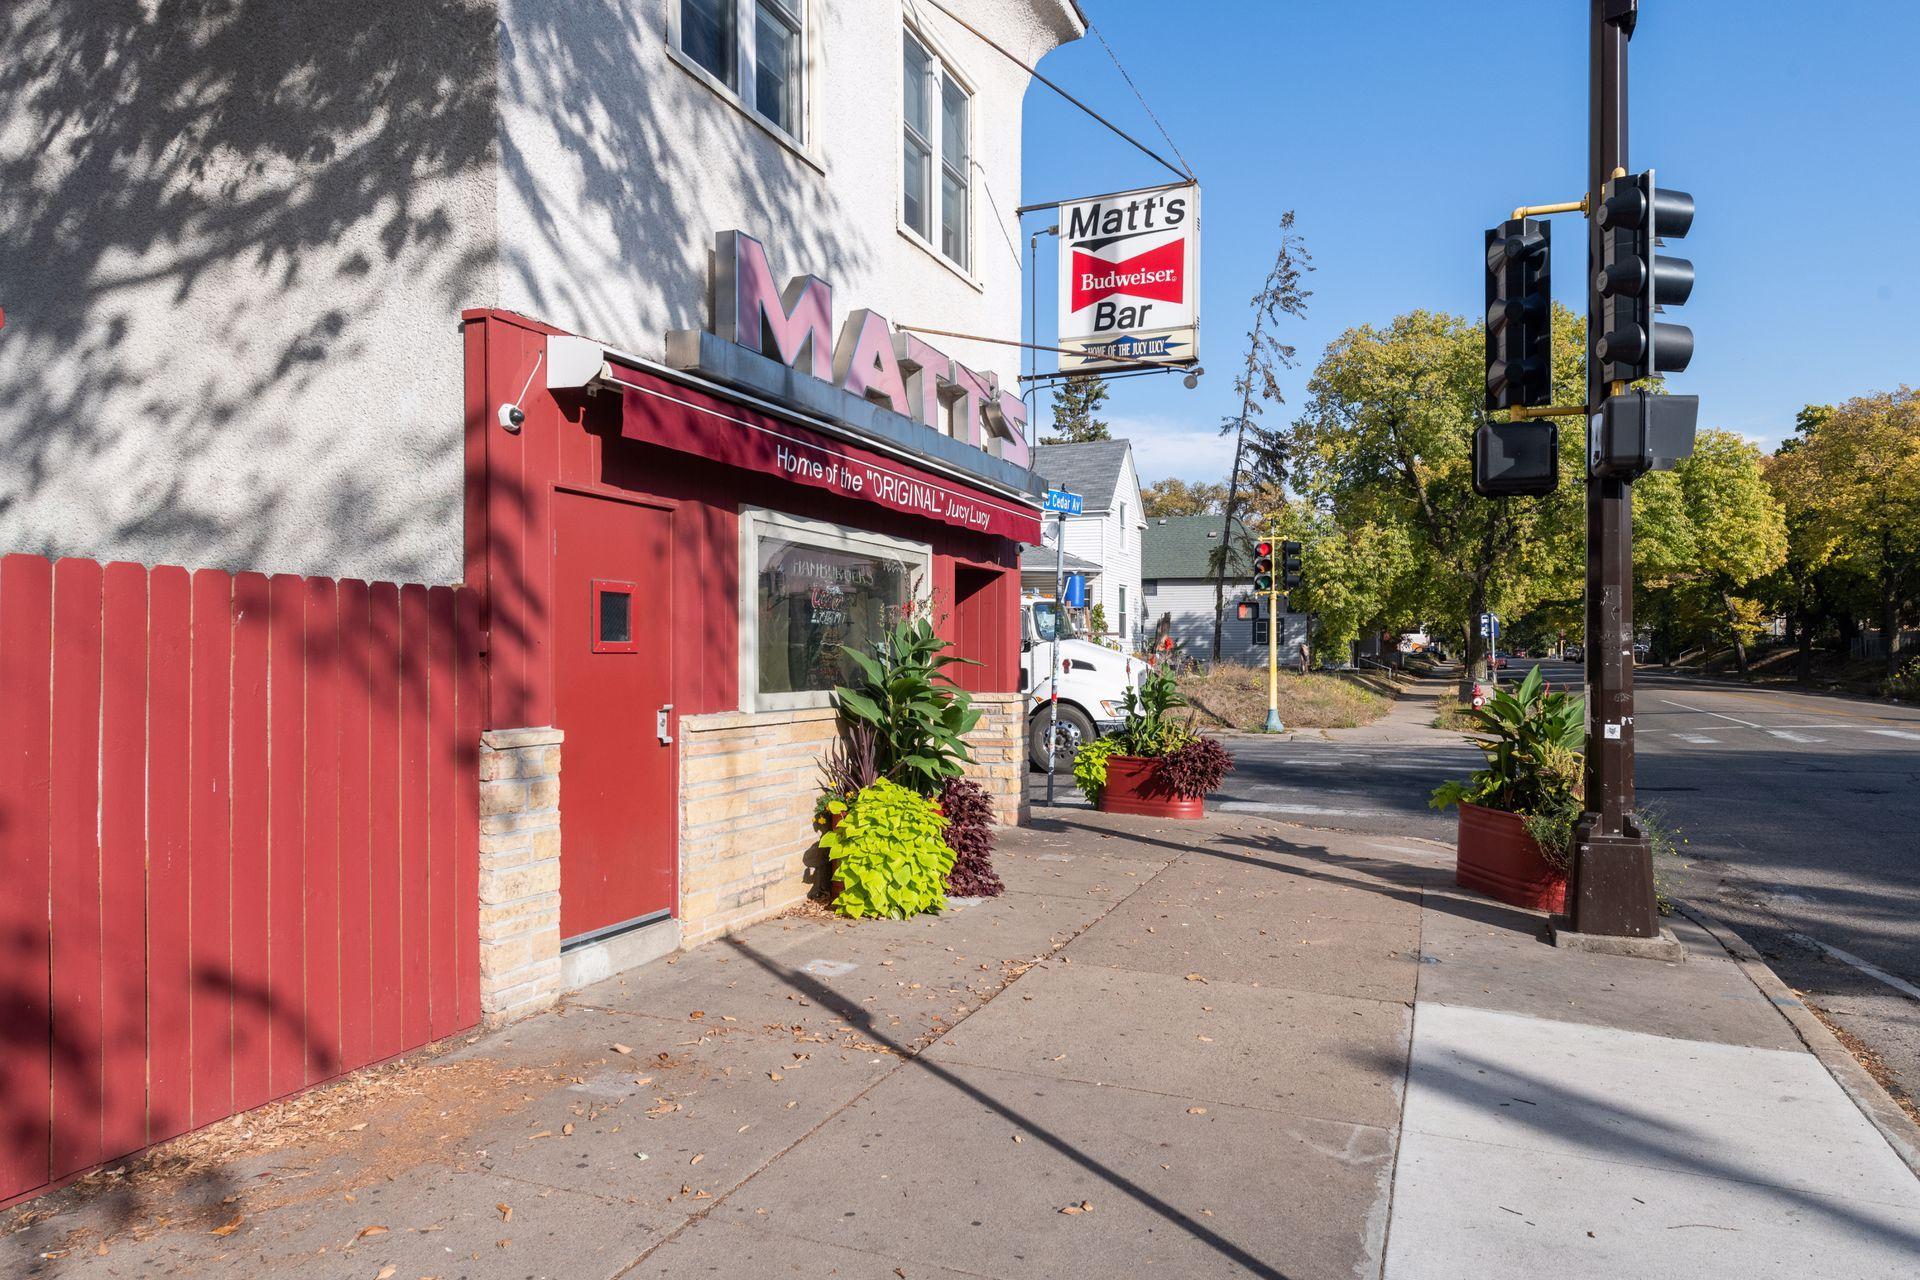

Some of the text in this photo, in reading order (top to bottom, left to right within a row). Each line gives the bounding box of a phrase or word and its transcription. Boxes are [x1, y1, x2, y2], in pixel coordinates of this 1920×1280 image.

[1068, 196, 1186, 240] Matt's
[1081, 267, 1173, 292] Budweiser
[1094, 301, 1153, 332] Bar
[1108, 344, 1116, 357] OF
[1118, 343, 1131, 356] THE
[1149, 339, 1165, 353] LUCY
[777, 445, 991, 530] Home of the "ORIGINAL" Jucy Lucy
[1052, 494, 1071, 510] Cedar
